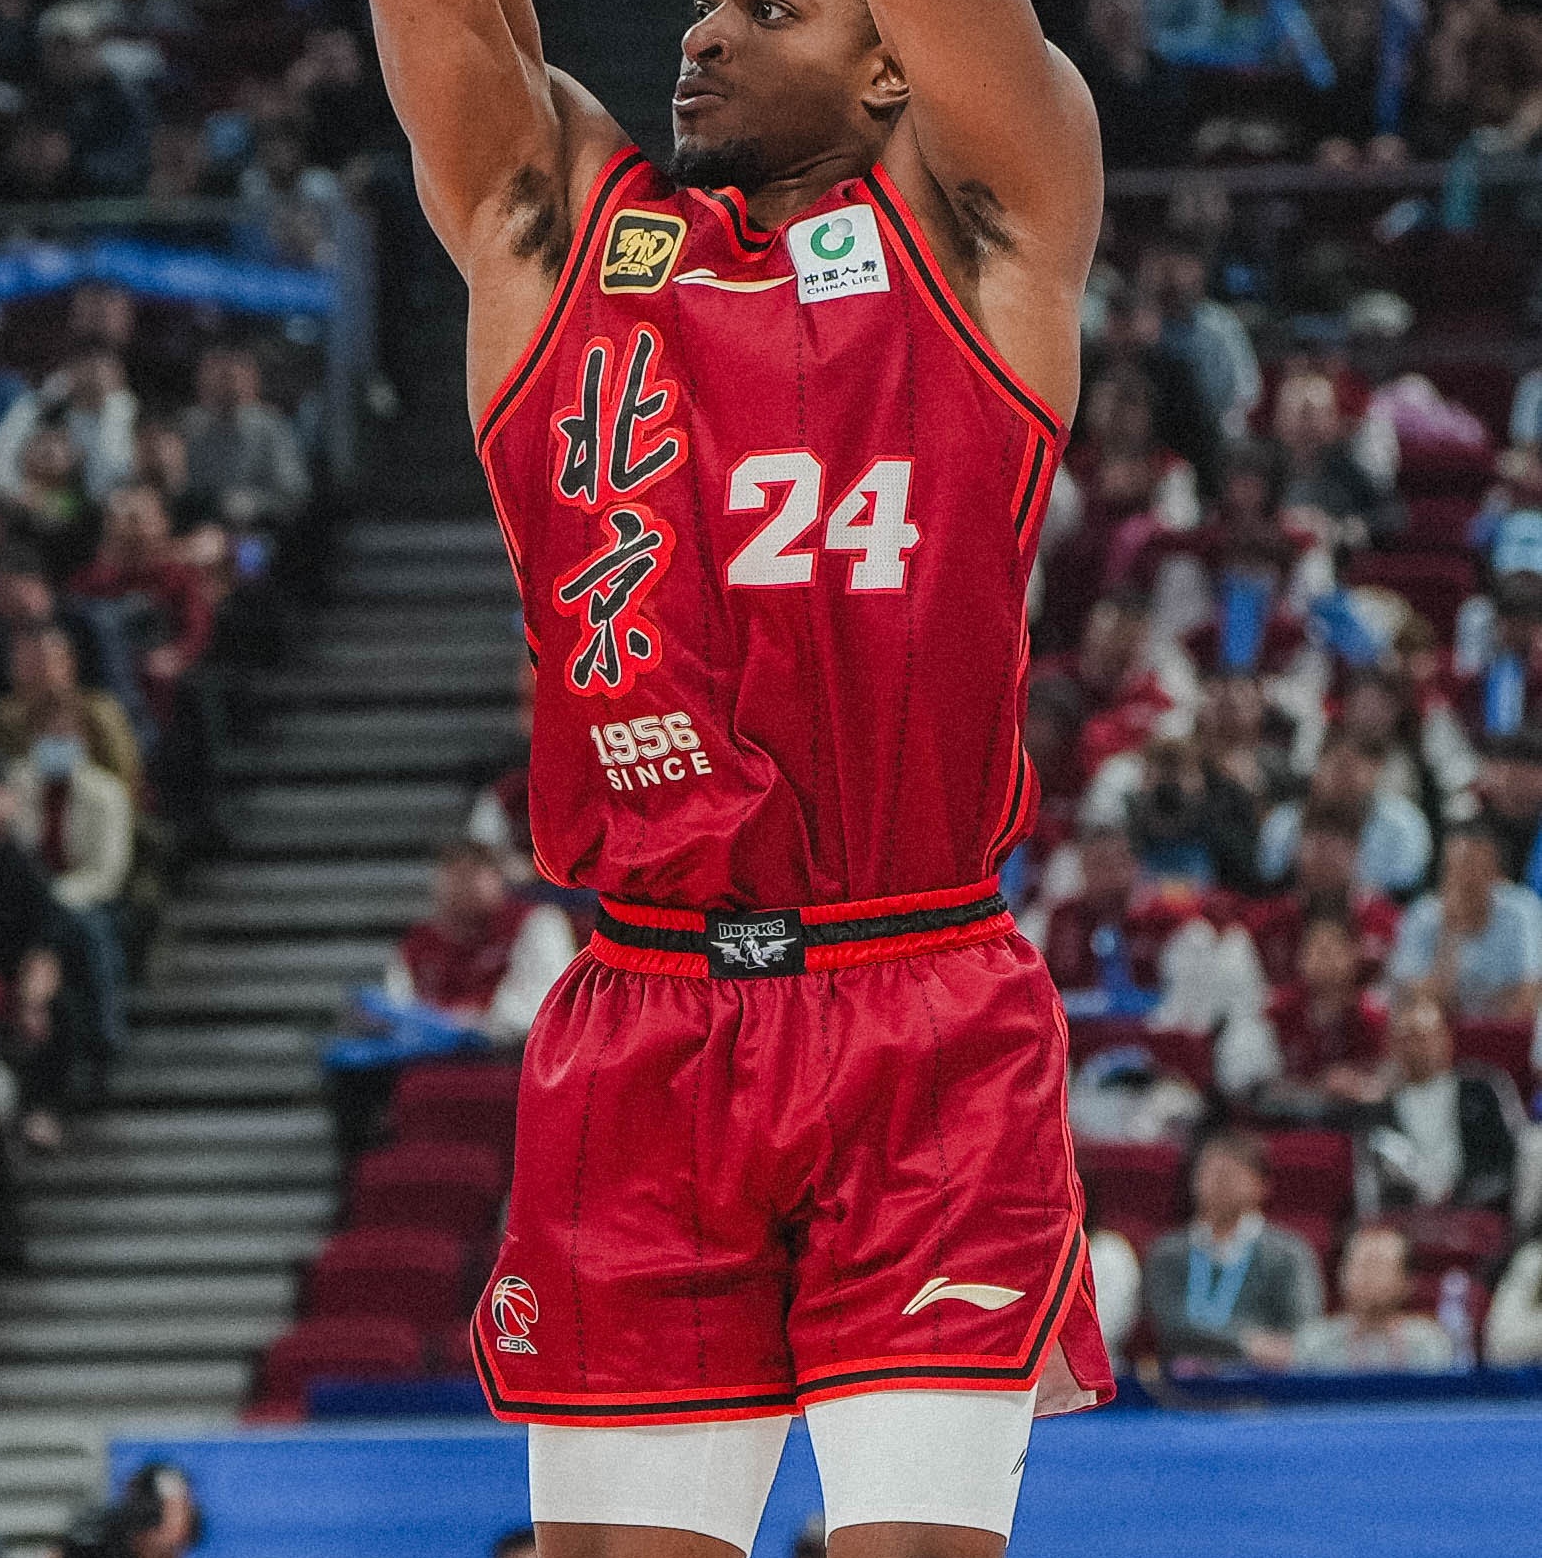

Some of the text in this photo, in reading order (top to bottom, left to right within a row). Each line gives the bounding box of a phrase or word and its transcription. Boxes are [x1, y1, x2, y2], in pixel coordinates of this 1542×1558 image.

[804, 260, 878, 286] 中国人寿
[806, 274, 881, 295] CHINA LIFE
[558, 330, 680, 691] 北京
[722, 446, 925, 595] 24
[590, 712, 702, 766] 1956
[606, 751, 712, 791] SINCE
[718, 918, 786, 940] DUCKS
[496, 1335, 538, 1355] CBA
